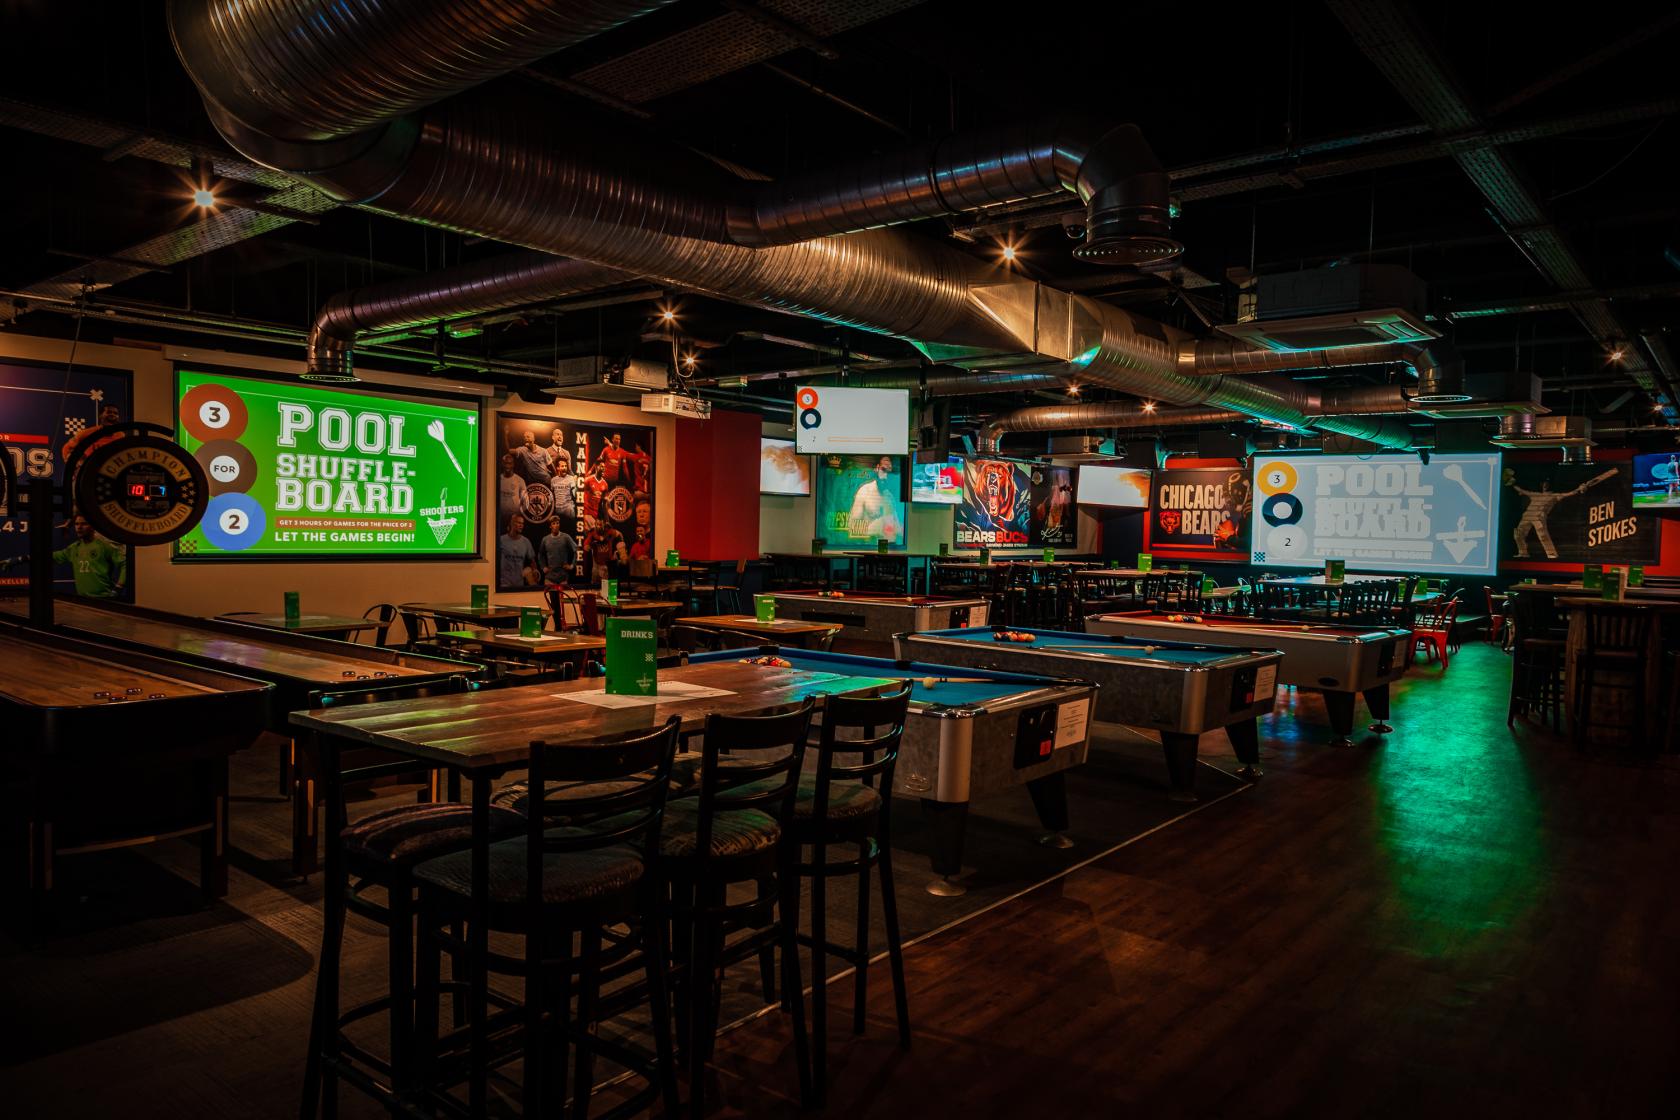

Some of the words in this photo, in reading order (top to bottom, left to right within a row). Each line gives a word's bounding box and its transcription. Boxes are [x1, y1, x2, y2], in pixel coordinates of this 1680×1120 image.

[209, 407, 221, 423] 3
[277, 401, 416, 458] POOL
[106, 449, 187, 477] CHAMPION
[214, 464, 236, 473] FOR
[276, 453, 416, 483] SHUFFLE-
[1273, 474, 1281, 484] 3
[1315, 464, 1434, 496] POOL
[131, 485, 145, 496] 10
[275, 477, 414, 515] BOARD
[1160, 485, 1224, 509] CHICAGO
[575, 432, 588, 576] MANCHESTER
[1589, 501, 1615, 525] BEN
[104, 502, 190, 531] SHUFFLEBOARD
[229, 514, 241, 530] 2
[279, 519, 293, 527] GET
[300, 519, 322, 527] HOURS
[333, 520, 356, 528] GAMES
[274, 532, 299, 542] LET
[302, 532, 327, 542] THE
[330, 532, 374, 542] GAMES
[376, 532, 415, 543] BEGIN!
[956, 531, 996, 543] BEARS
[1588, 516, 1638, 547] STOKES
[1284, 537, 1292, 547] 2
[620, 630, 655, 639] DRINKS
